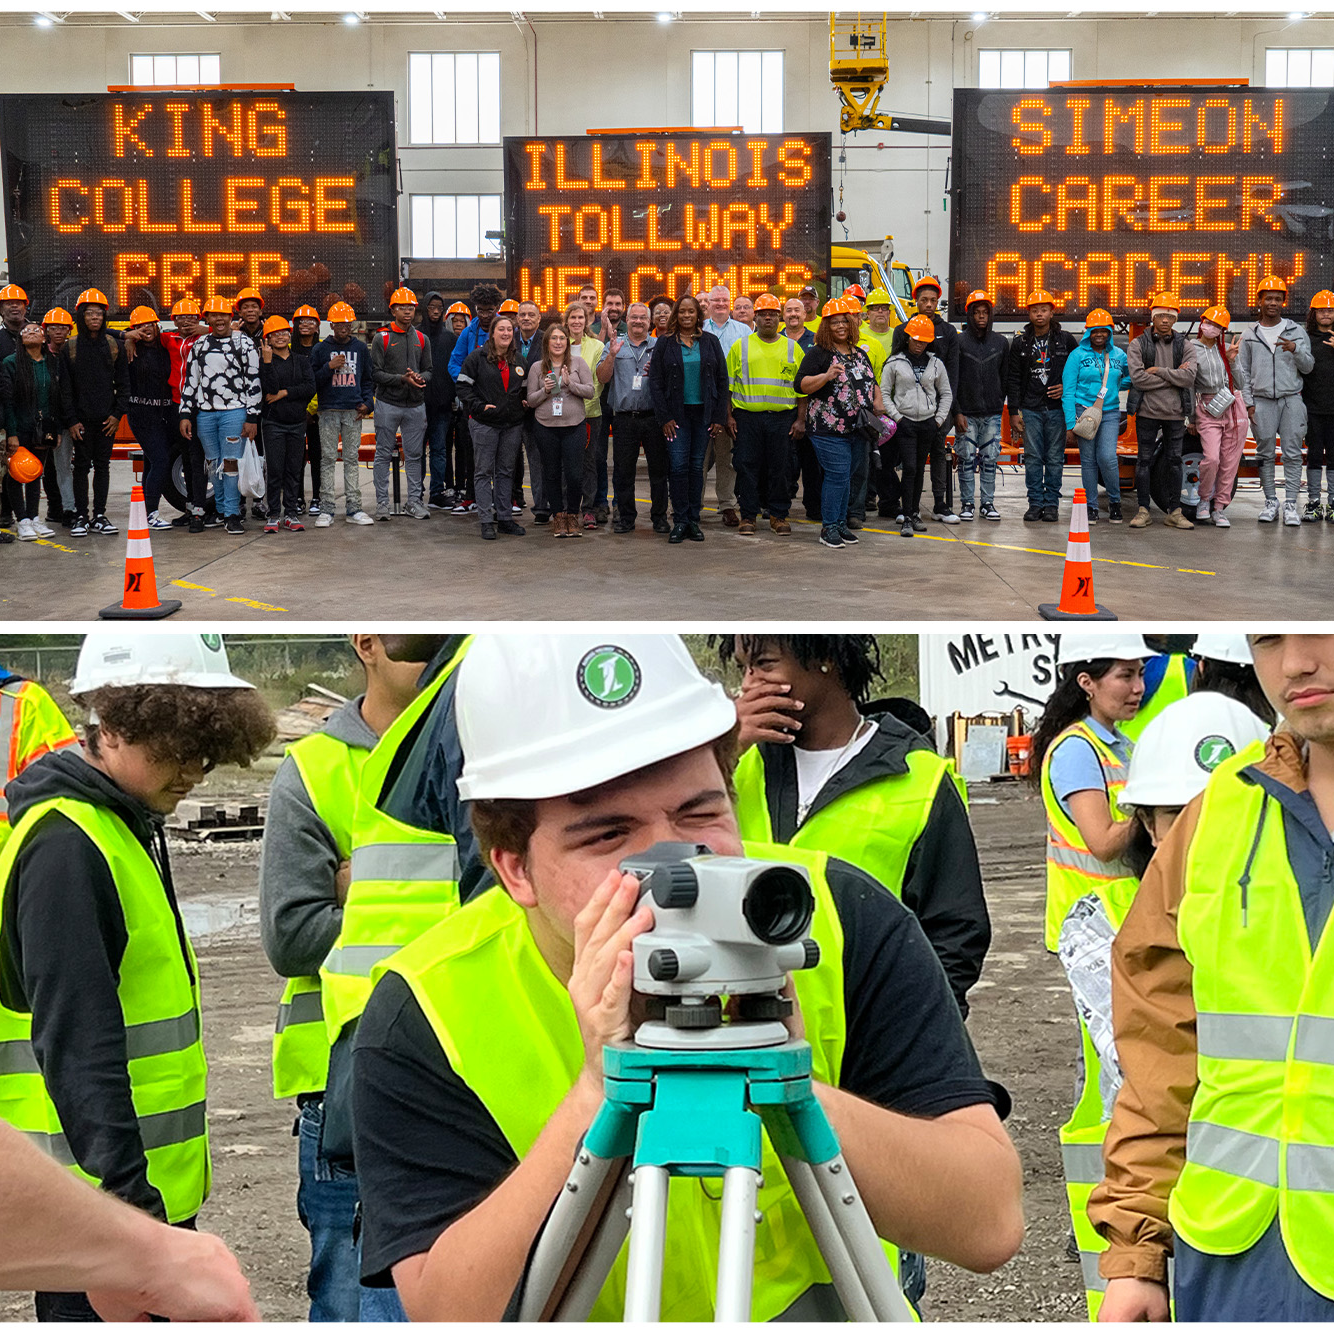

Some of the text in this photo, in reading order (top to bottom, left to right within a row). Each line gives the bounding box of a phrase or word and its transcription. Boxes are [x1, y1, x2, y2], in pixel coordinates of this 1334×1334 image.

[115, 102, 287, 157] KING
[1012, 98, 1284, 154] SIMEON
[525, 141, 812, 189] ILLINOIS
[50, 176, 356, 233] COLLEGE
[539, 203, 794, 250] TOLLWAY
[1010, 176, 1281, 231] CAREER
[116, 253, 289, 307] PREP
[128, 396, 161, 406] ARMANI
